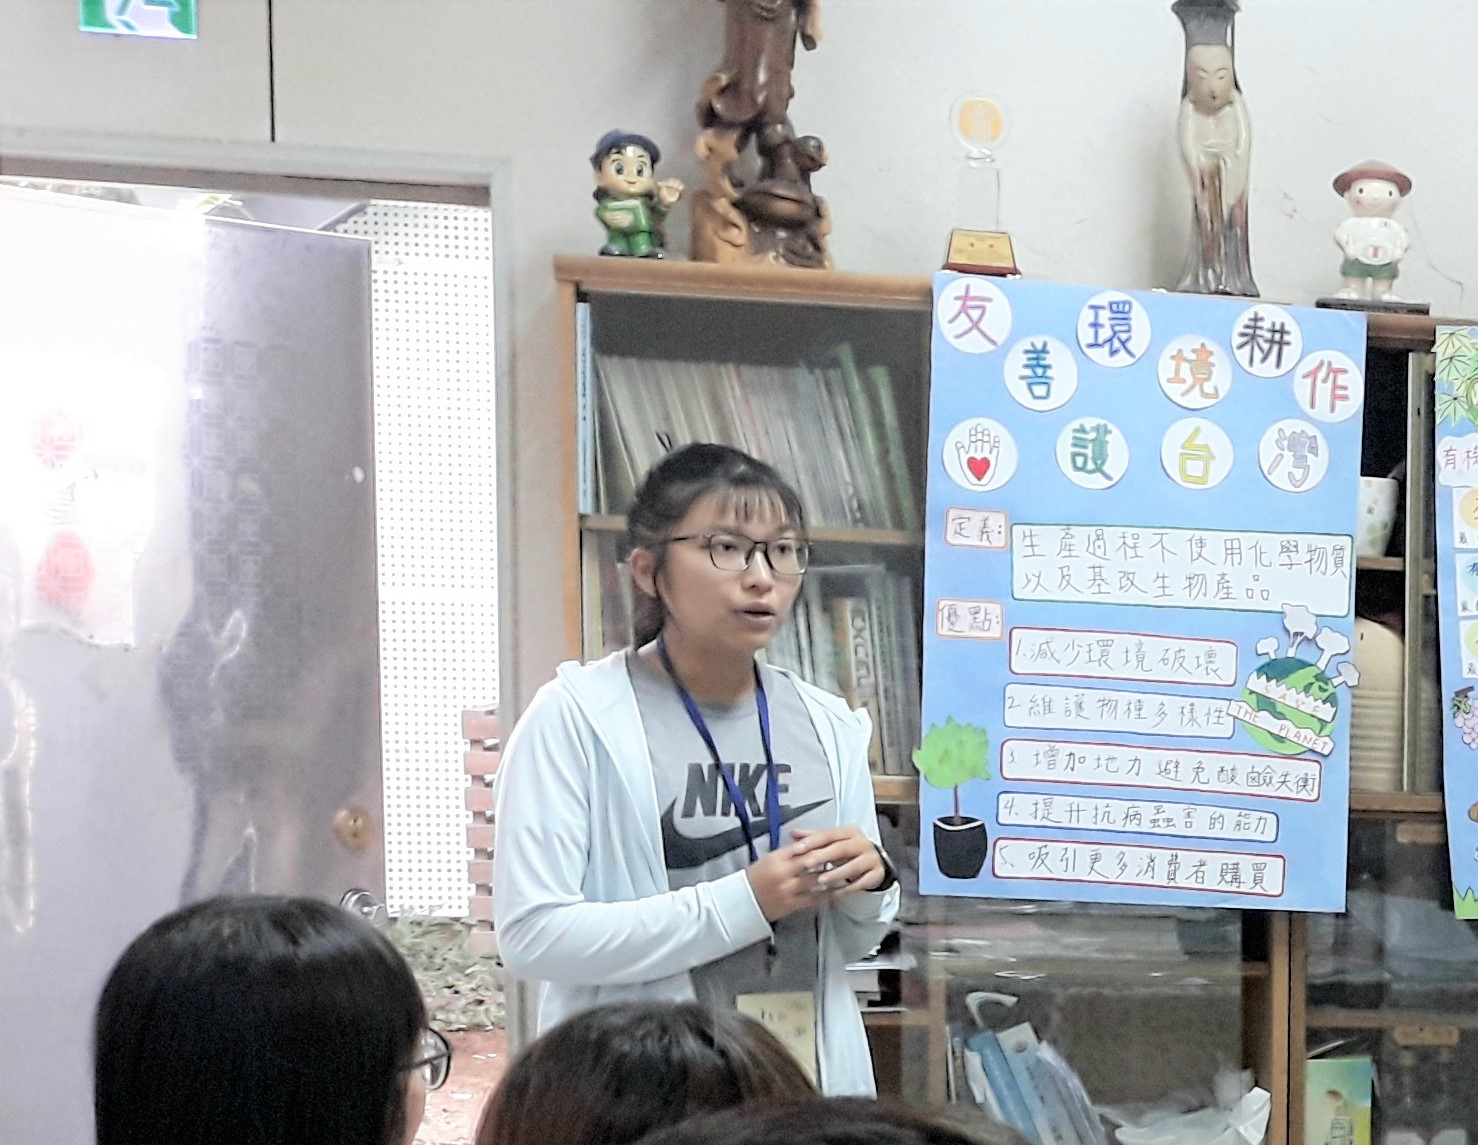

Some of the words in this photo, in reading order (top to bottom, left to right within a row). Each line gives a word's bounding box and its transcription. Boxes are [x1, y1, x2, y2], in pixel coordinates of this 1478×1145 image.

[1021, 525, 1347, 579] 生產過程不使用化學物質
[1020, 564, 1271, 601] 以及基改生物產品
[1236, 703, 1261, 723] THE
[1278, 722, 1330, 753] PLANET
[681, 762, 792, 819] NIKE
